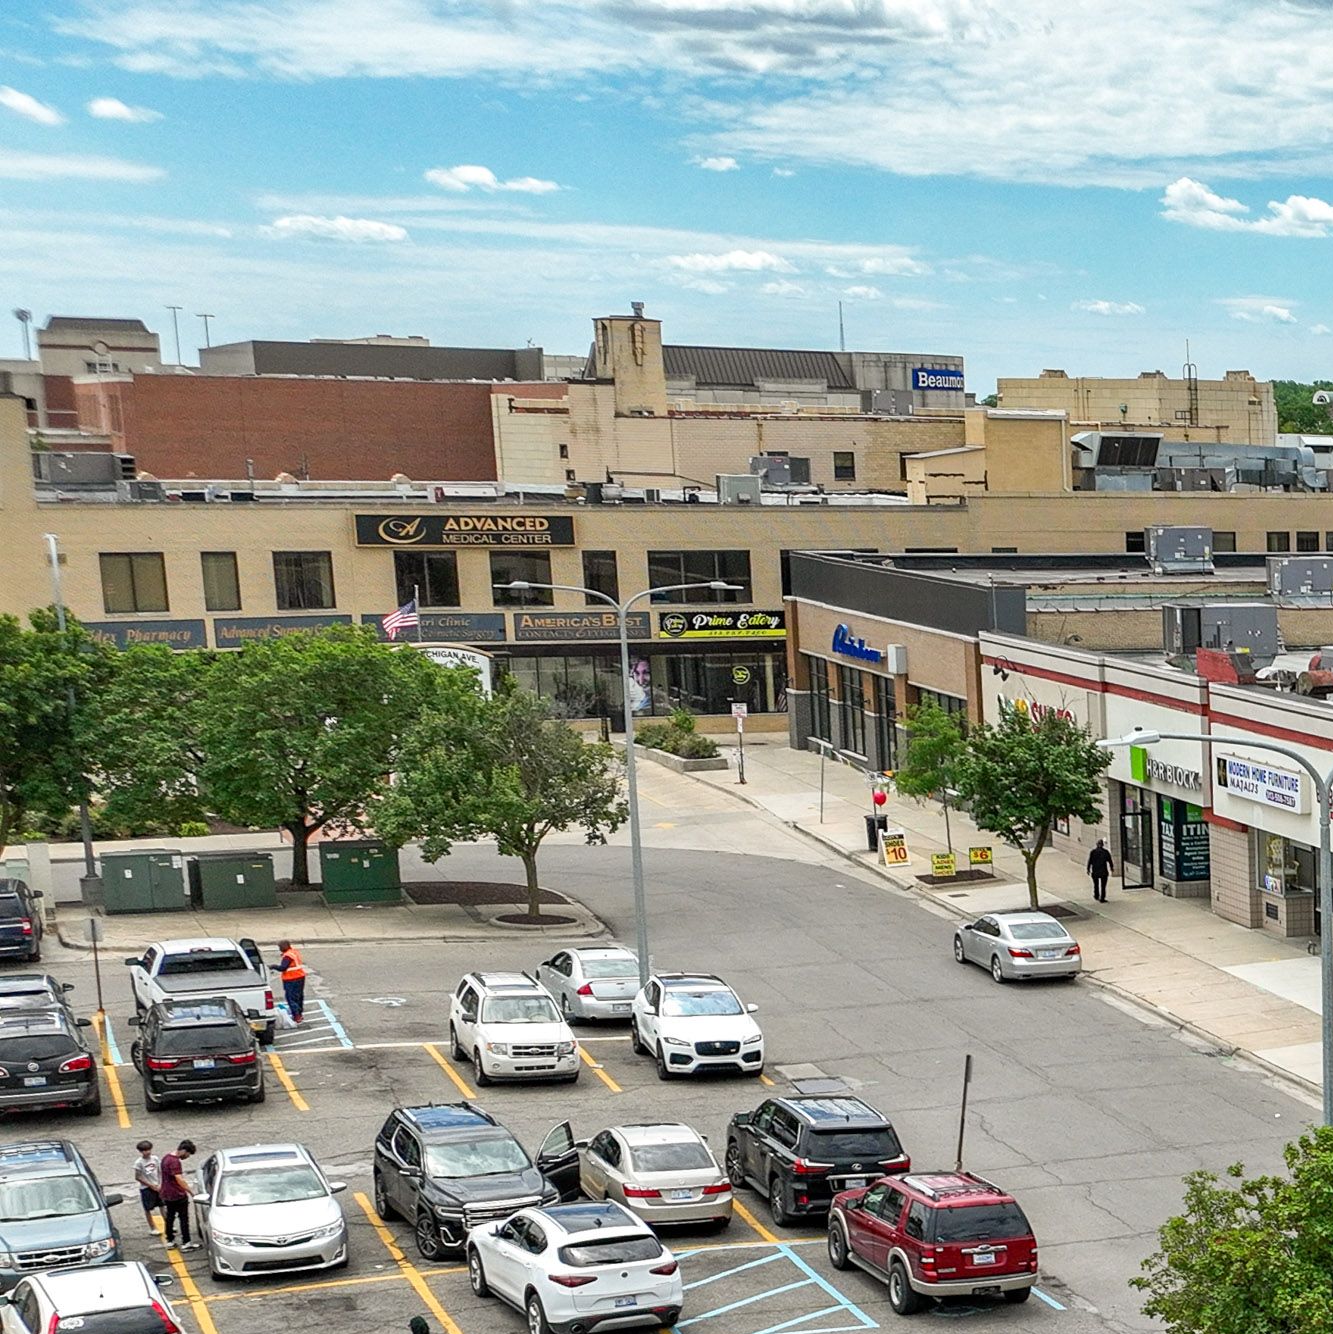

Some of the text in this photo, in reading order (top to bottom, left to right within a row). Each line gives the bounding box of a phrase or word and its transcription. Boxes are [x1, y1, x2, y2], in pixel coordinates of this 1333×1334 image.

[444, 516, 549, 531] ADVANCED
[442, 534, 552, 544] MEDICAL CENTER
[438, 616, 471, 627] Clinic
[521, 614, 601, 628] AMERICA'S
[692, 613, 734, 630] Prime
[737, 613, 780, 629] Eatery
[127, 627, 192, 642] Pharmacy
[220, 625, 270, 639] Advanced
[1146, 759, 1197, 790] H&R BLOCK
[1228, 760, 1299, 793] MODERN HOME FURNITURE
[1161, 820, 1175, 838] TAX
